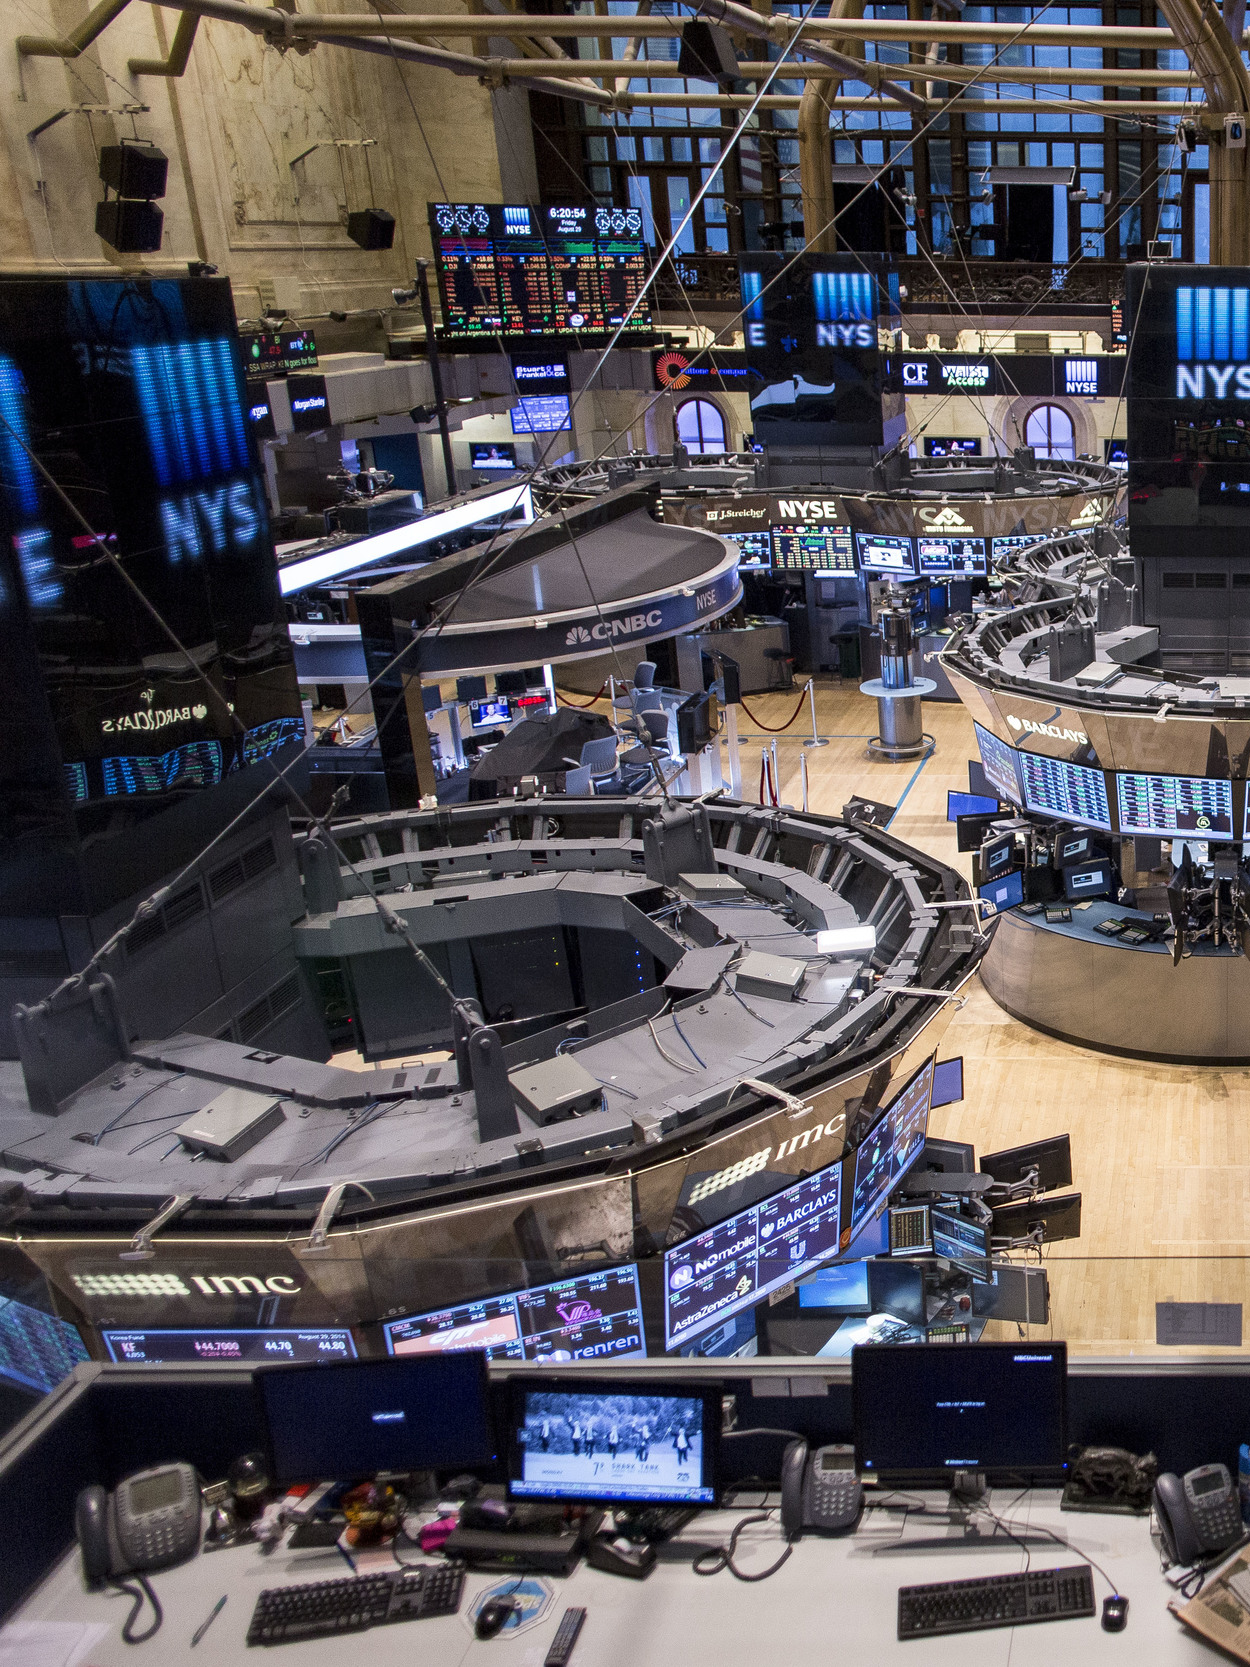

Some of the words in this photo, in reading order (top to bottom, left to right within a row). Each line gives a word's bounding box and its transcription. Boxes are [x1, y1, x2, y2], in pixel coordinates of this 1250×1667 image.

[549, 208, 586, 218] 6:20:54
[561, 219, 577, 227] Friday
[505, 225, 532, 235] NYSE
[515, 365, 546, 373] Stuart
[902, 364, 928, 381] CF
[947, 376, 987, 386] Access
[1065, 382, 1098, 394] NYSE
[719, 508, 766, 520] J.Streicher
[778, 500, 838, 519] NYSE
[943, 525, 974, 533] FINANCIAL
[696, 588, 716, 612] NYSE
[591, 609, 663, 640] CNBC
[472, 701, 477, 709] 6
[1021, 718, 1089, 745] BARCLAYS
[774, 1113, 847, 1162] imc
[907, 1133, 922, 1155] VALE
[776, 1189, 837, 1231] BARCLAYS
[190, 1275, 302, 1295] imc
[672, 1290, 739, 1334] AstraZeneca
[121, 1342, 136, 1352] KF
[201, 1341, 240, 1351] 44.7000
[265, 1341, 292, 1351] 44.70
[318, 1341, 346, 1351] 44.80
[573, 1335, 639, 1360] renren
[611, 1462, 636, 1470] SHARK
[639, 1463, 660, 1471] TANK
